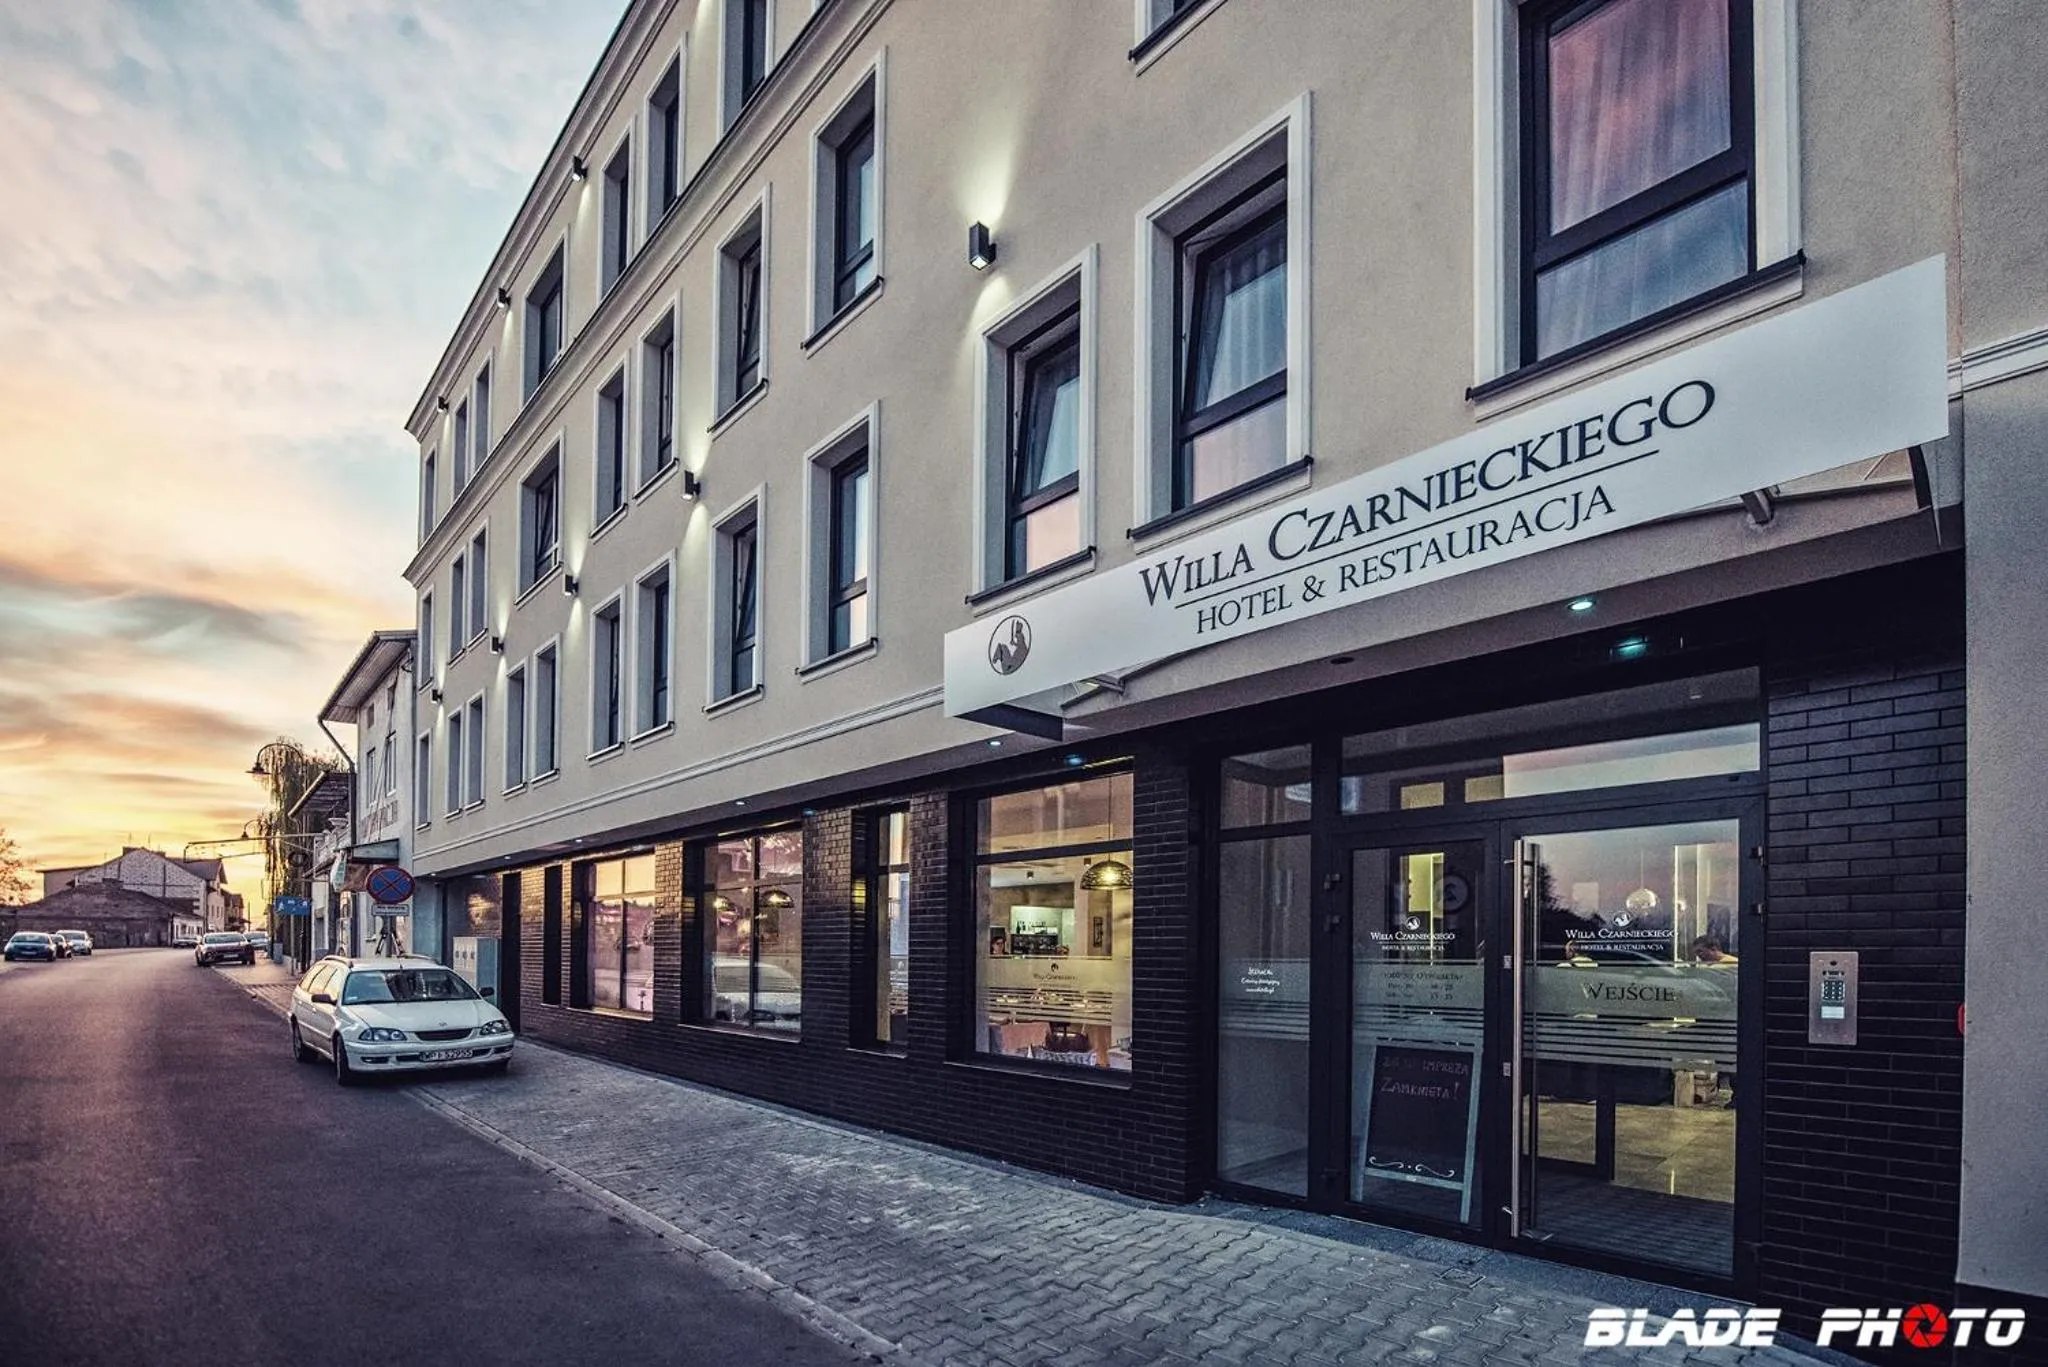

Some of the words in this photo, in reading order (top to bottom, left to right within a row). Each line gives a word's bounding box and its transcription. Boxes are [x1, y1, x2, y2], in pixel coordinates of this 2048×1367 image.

[1139, 543, 1254, 606] WILLA
[1268, 380, 1716, 561] CZARNIECKIEGO
[1197, 585, 1292, 634] HOTEL
[1302, 575, 1326, 602] &
[1339, 485, 1616, 592] RESTAURACJA
[1565, 929, 1596, 939] WILLA
[1598, 928, 1678, 939] CZARNIECKIEGO
[1581, 982, 1676, 1001] WEJŚCIE
